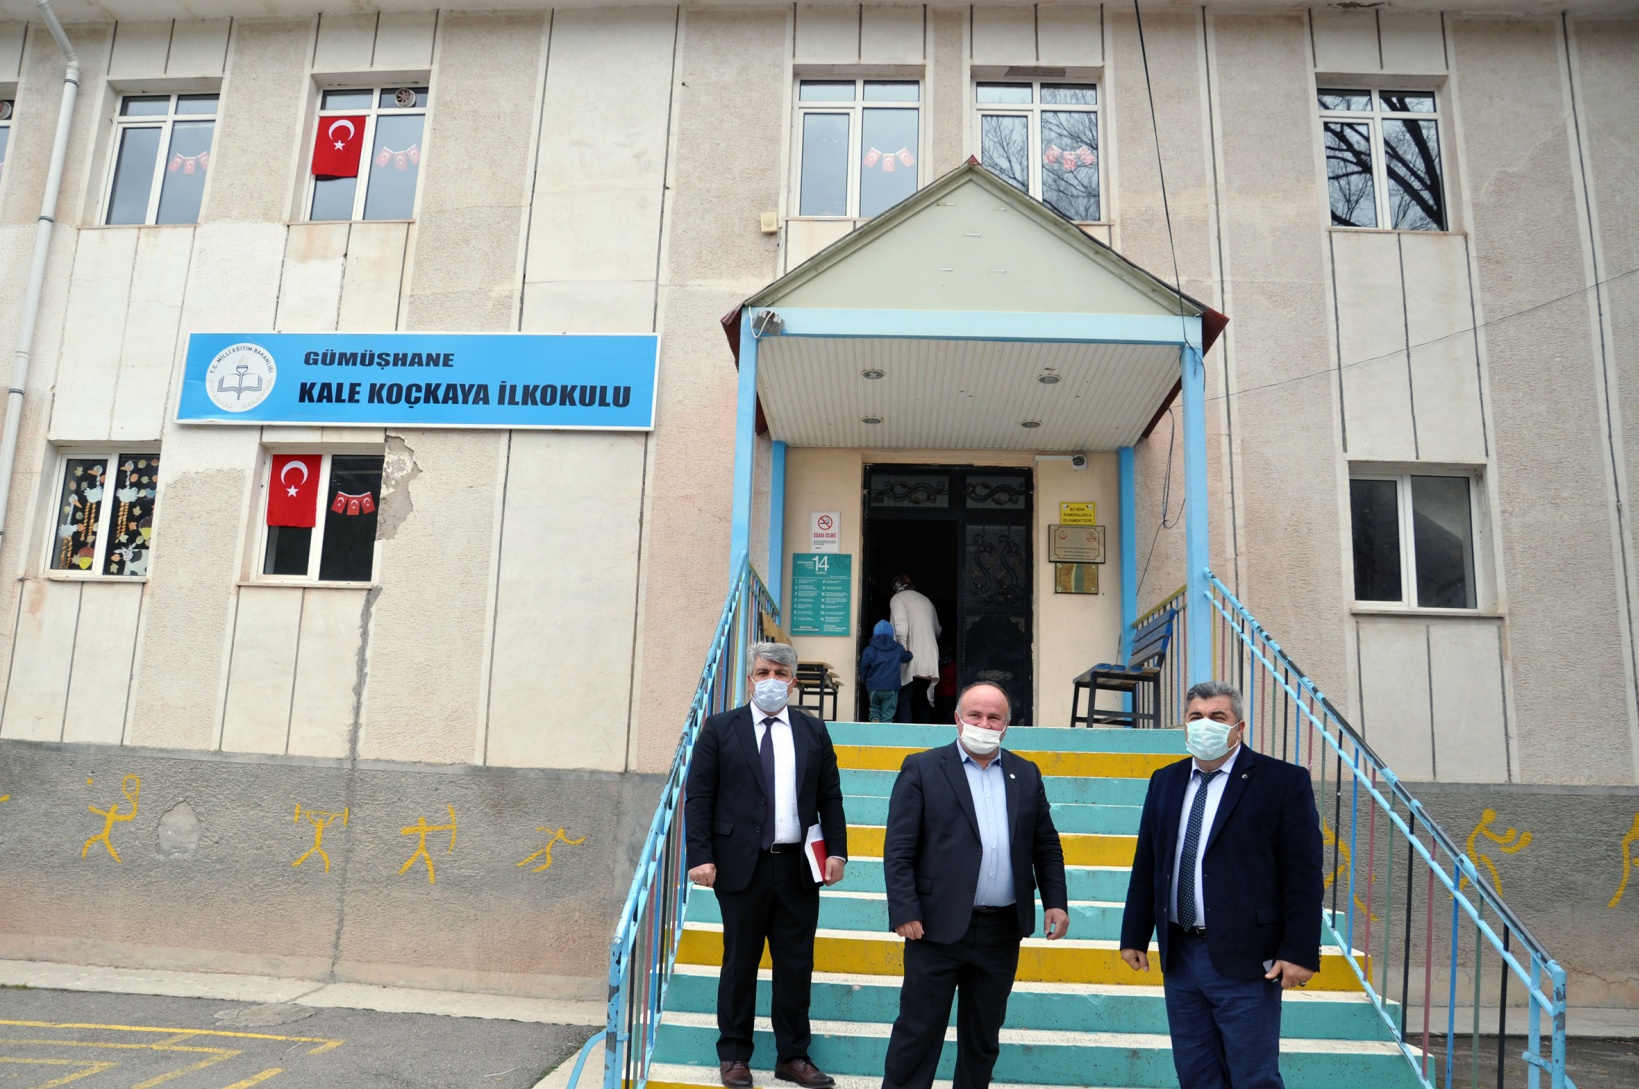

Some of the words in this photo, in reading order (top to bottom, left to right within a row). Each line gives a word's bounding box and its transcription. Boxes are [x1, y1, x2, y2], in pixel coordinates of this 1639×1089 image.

[217, 350, 232, 363] MİLLİ
[232, 345, 253, 353] EĞİTİM
[253, 348, 274, 374] BAKANLIĞI
[304, 349, 454, 370] GÜMÜŞHANE
[299, 382, 362, 404] KALE
[368, 383, 490, 409] KOÇKAYA
[497, 380, 631, 408] İLKOKULU
[812, 555, 829, 571] 14
